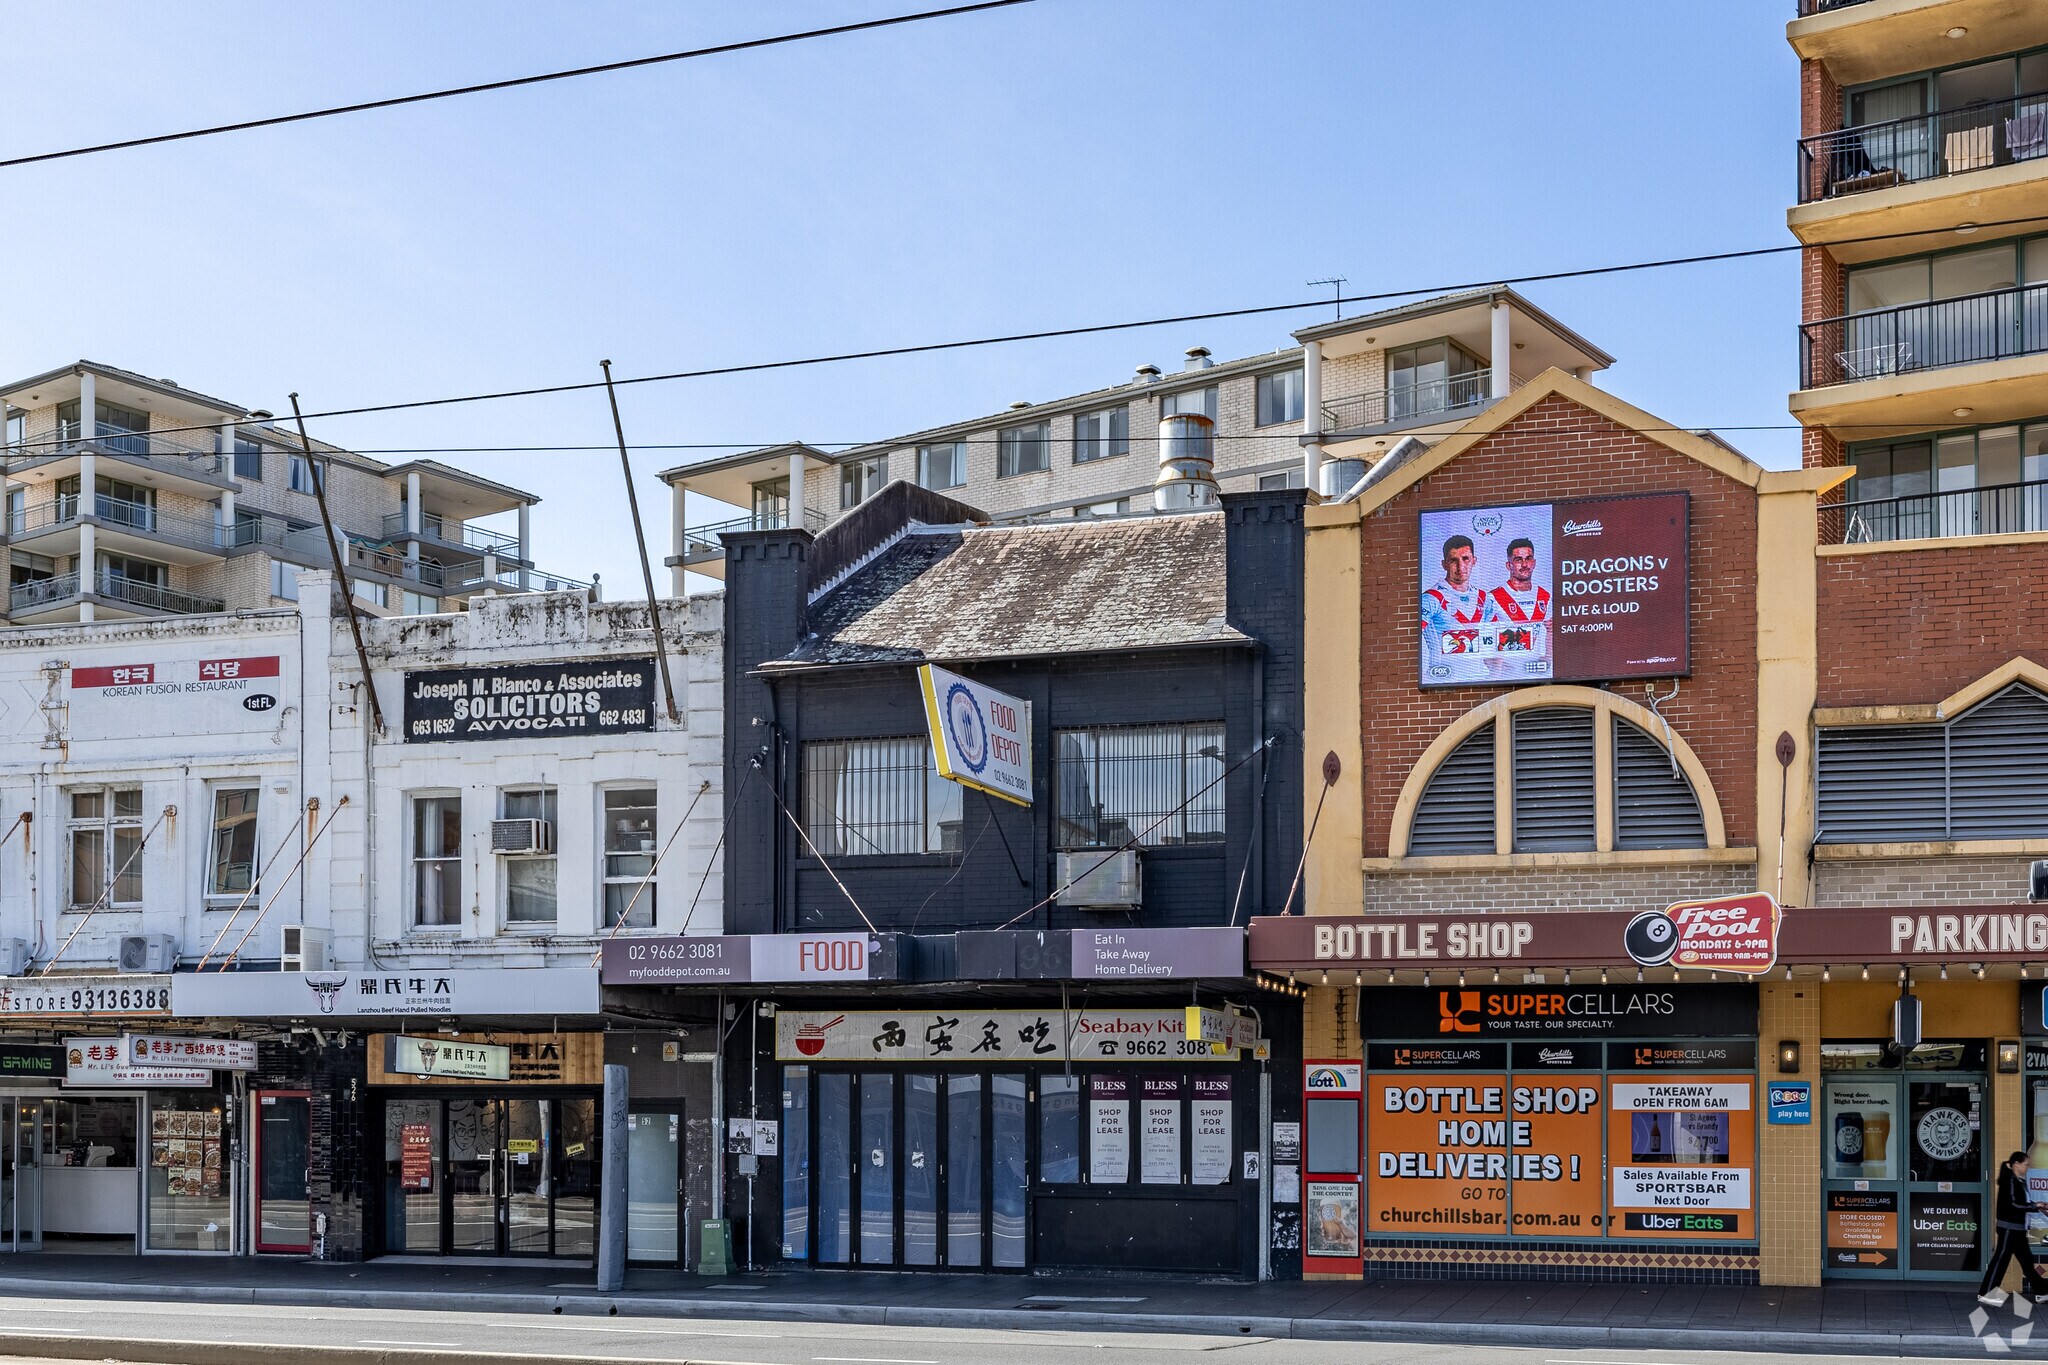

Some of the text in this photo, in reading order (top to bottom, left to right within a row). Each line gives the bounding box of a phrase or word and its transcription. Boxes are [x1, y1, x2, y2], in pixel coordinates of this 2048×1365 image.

[1562, 519, 1601, 533] Churchills
[1562, 555, 1668, 575] DRAGONS v
[1562, 576, 1659, 596] ROOSTERS
[1561, 602, 1639, 616] LIVE & LOUD
[1561, 622, 1613, 633] SAT 4:00PM
[1483, 637, 1493, 645] VS
[113, 661, 240, 685] 한국 식당
[103, 680, 247, 697] KOREAN FUSION RESTAURANT
[413, 672, 642, 700] Joseph M. Blanco & Associates
[454, 693, 600, 720] SOLICITORS
[600, 709, 646, 725] 662 4831
[990, 700, 1016, 733] FOOD
[413, 719, 454, 735] 663 1652
[468, 716, 586, 732] AVVOCATI
[991, 733, 1021, 767] DEPOT
[994, 769, 1027, 791] 02 9662 3081
[1677, 907, 1747, 924] Free
[1654, 925, 1665, 938] 8
[1683, 918, 1761, 939] Pool
[1891, 913, 2048, 953] PARKING
[1095, 933, 1125, 945] Eat In
[1314, 922, 1533, 959] BOTTLE SHOP
[1680, 939, 1768, 950] MONDAYS 6-9PM
[629, 943, 723, 959] 02 9662 3081
[799, 940, 864, 972] FOOD
[1095, 949, 1150, 962] Take Away
[629, 966, 730, 980] myfooddepot.com.au
[1095, 963, 1173, 978] Home Delivery
[15, 997, 65, 1010] STORE
[72, 990, 169, 1010] 93136388
[1488, 993, 1675, 1016] SUPERCELLARS
[1080, 1018, 1154, 1037] Seabay
[1488, 1020, 1615, 1029] YOUR TASTE. OUR SPECIALTY.
[1126, 1041, 1166, 1055] 9662
[1412, 1050, 1480, 1060] SUPERCELLARS
[1539, 1048, 1573, 1059] Churchills
[1654, 1049, 1726, 1059] SUPERCELLARS
[3, 1056, 52, 1070] GAMING
[171, 1056, 189, 1064] Guangxi
[1094, 1081, 1126, 1091] BLESS
[1145, 1081, 1177, 1091] BLESS
[1195, 1081, 1229, 1091] BLESS
[1308, 1077, 1334, 1087] Lott
[1648, 1087, 1713, 1097] TAKEAWAY
[1774, 1091, 1806, 1102] KENO
[1385, 1087, 1599, 1115] BOTTLE SHOP
[1633, 1098, 1728, 1108] OPEN FROM 6AM
[1778, 1110, 1809, 1119] play here
[1923, 1110, 1966, 1128] HAWKE'S
[1439, 1120, 1533, 1147] HOME
[1697, 1122, 1719, 1131] Brandy
[1923, 1138, 1960, 1157] BREWING
[1378, 1152, 1581, 1181] DELIVERIES !
[1623, 1170, 1740, 1181] Sales Available From
[1461, 1187, 1506, 1201] GO TO
[1636, 1183, 1726, 1194] SPORTSBAR
[1654, 1195, 1710, 1206] Next Door
[1846, 1197, 1890, 1205] SUPERCELLARS
[1380, 1207, 1581, 1227] churchillsbar.com.au
[1642, 1214, 1723, 1229] Uber Eats
[1913, 1219, 1978, 1231] Uber Eats
